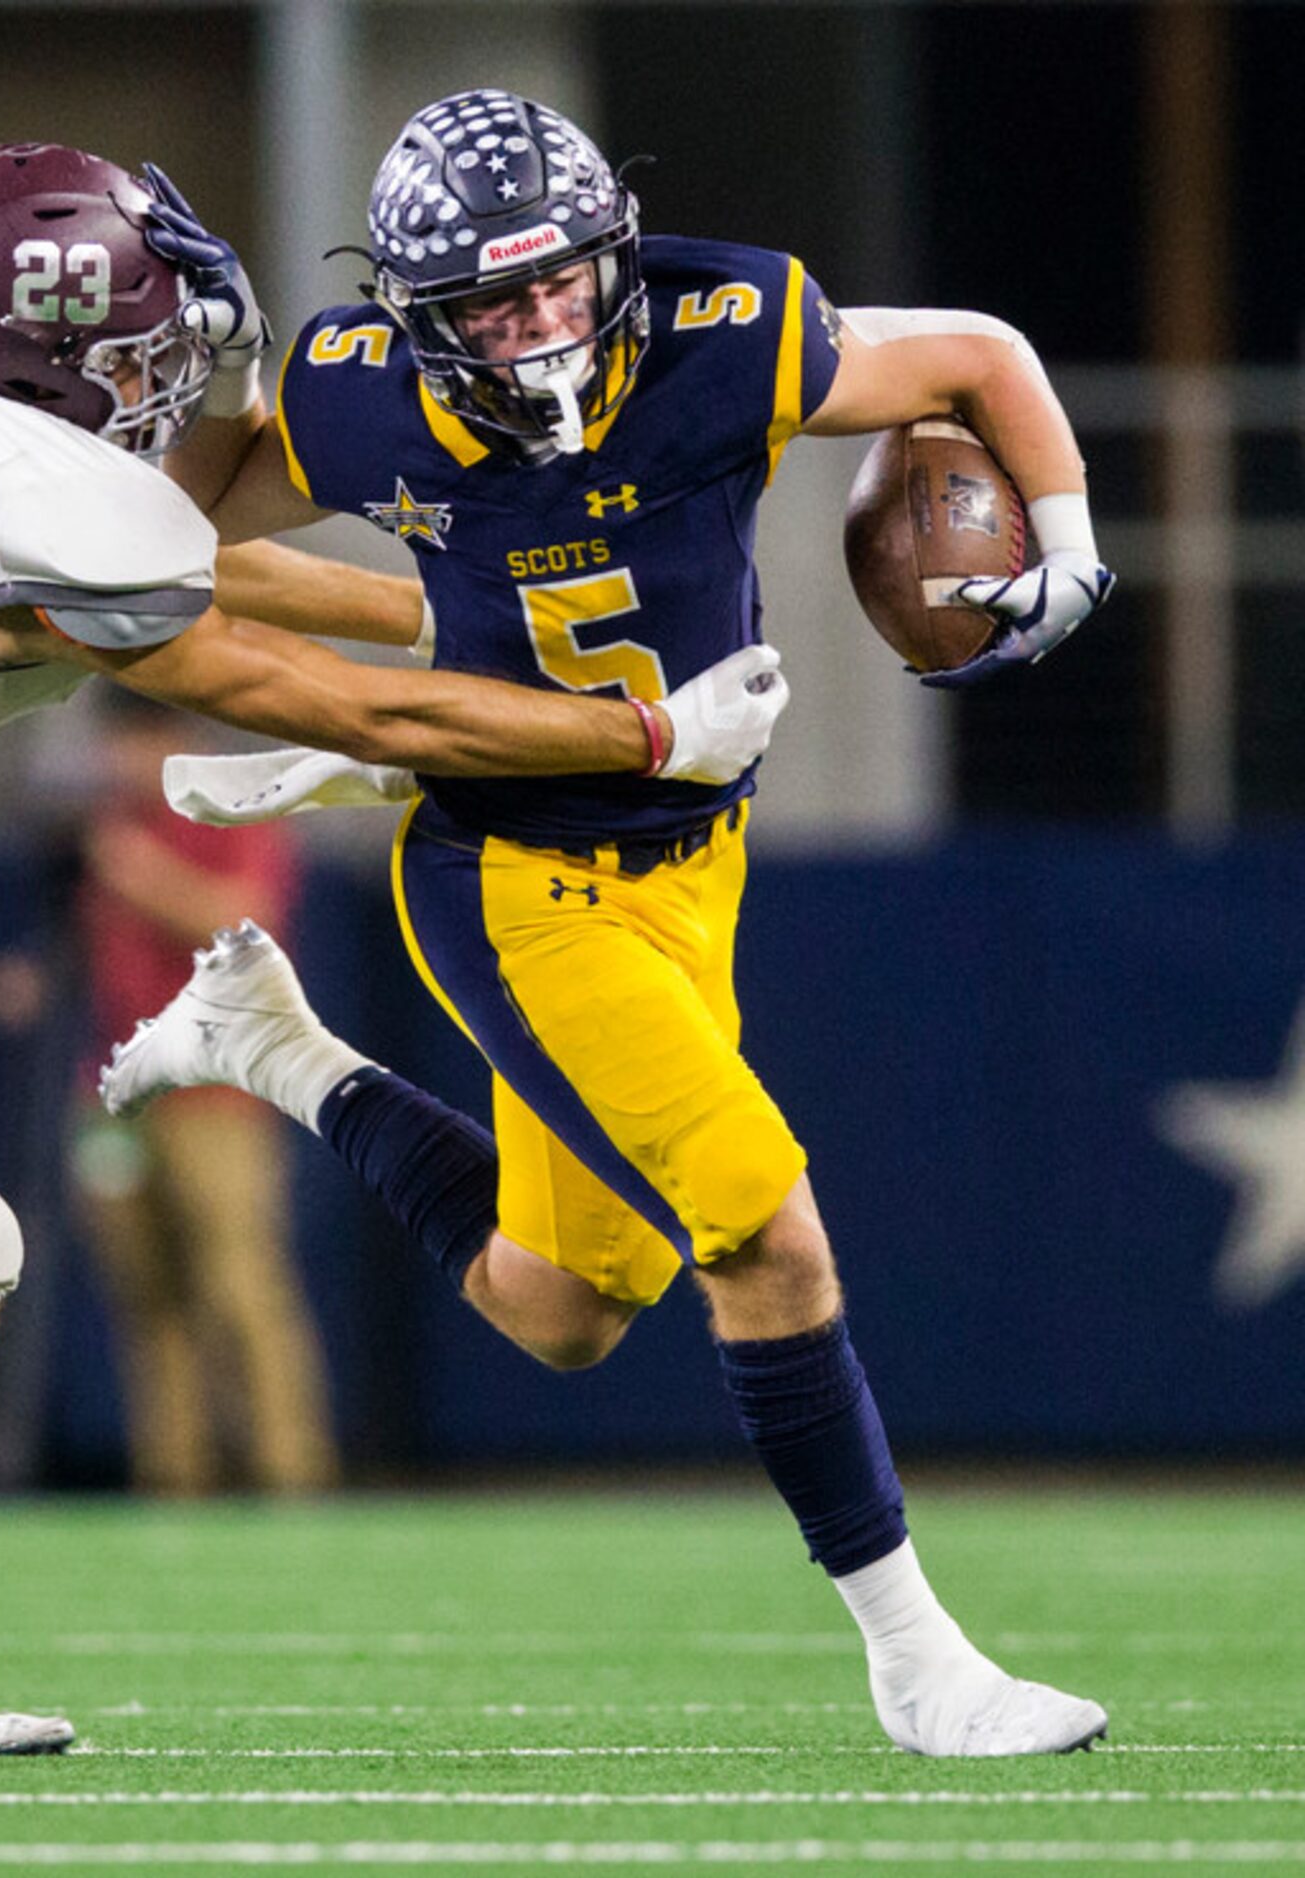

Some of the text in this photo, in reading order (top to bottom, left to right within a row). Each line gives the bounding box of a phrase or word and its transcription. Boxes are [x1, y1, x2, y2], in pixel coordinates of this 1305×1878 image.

[488, 229, 557, 262] Riddell
[12, 239, 110, 325] 23
[673, 282, 762, 332] 5
[306, 323, 394, 368] 5
[507, 538, 611, 578] SCOTS
[517, 566, 669, 702] 5
